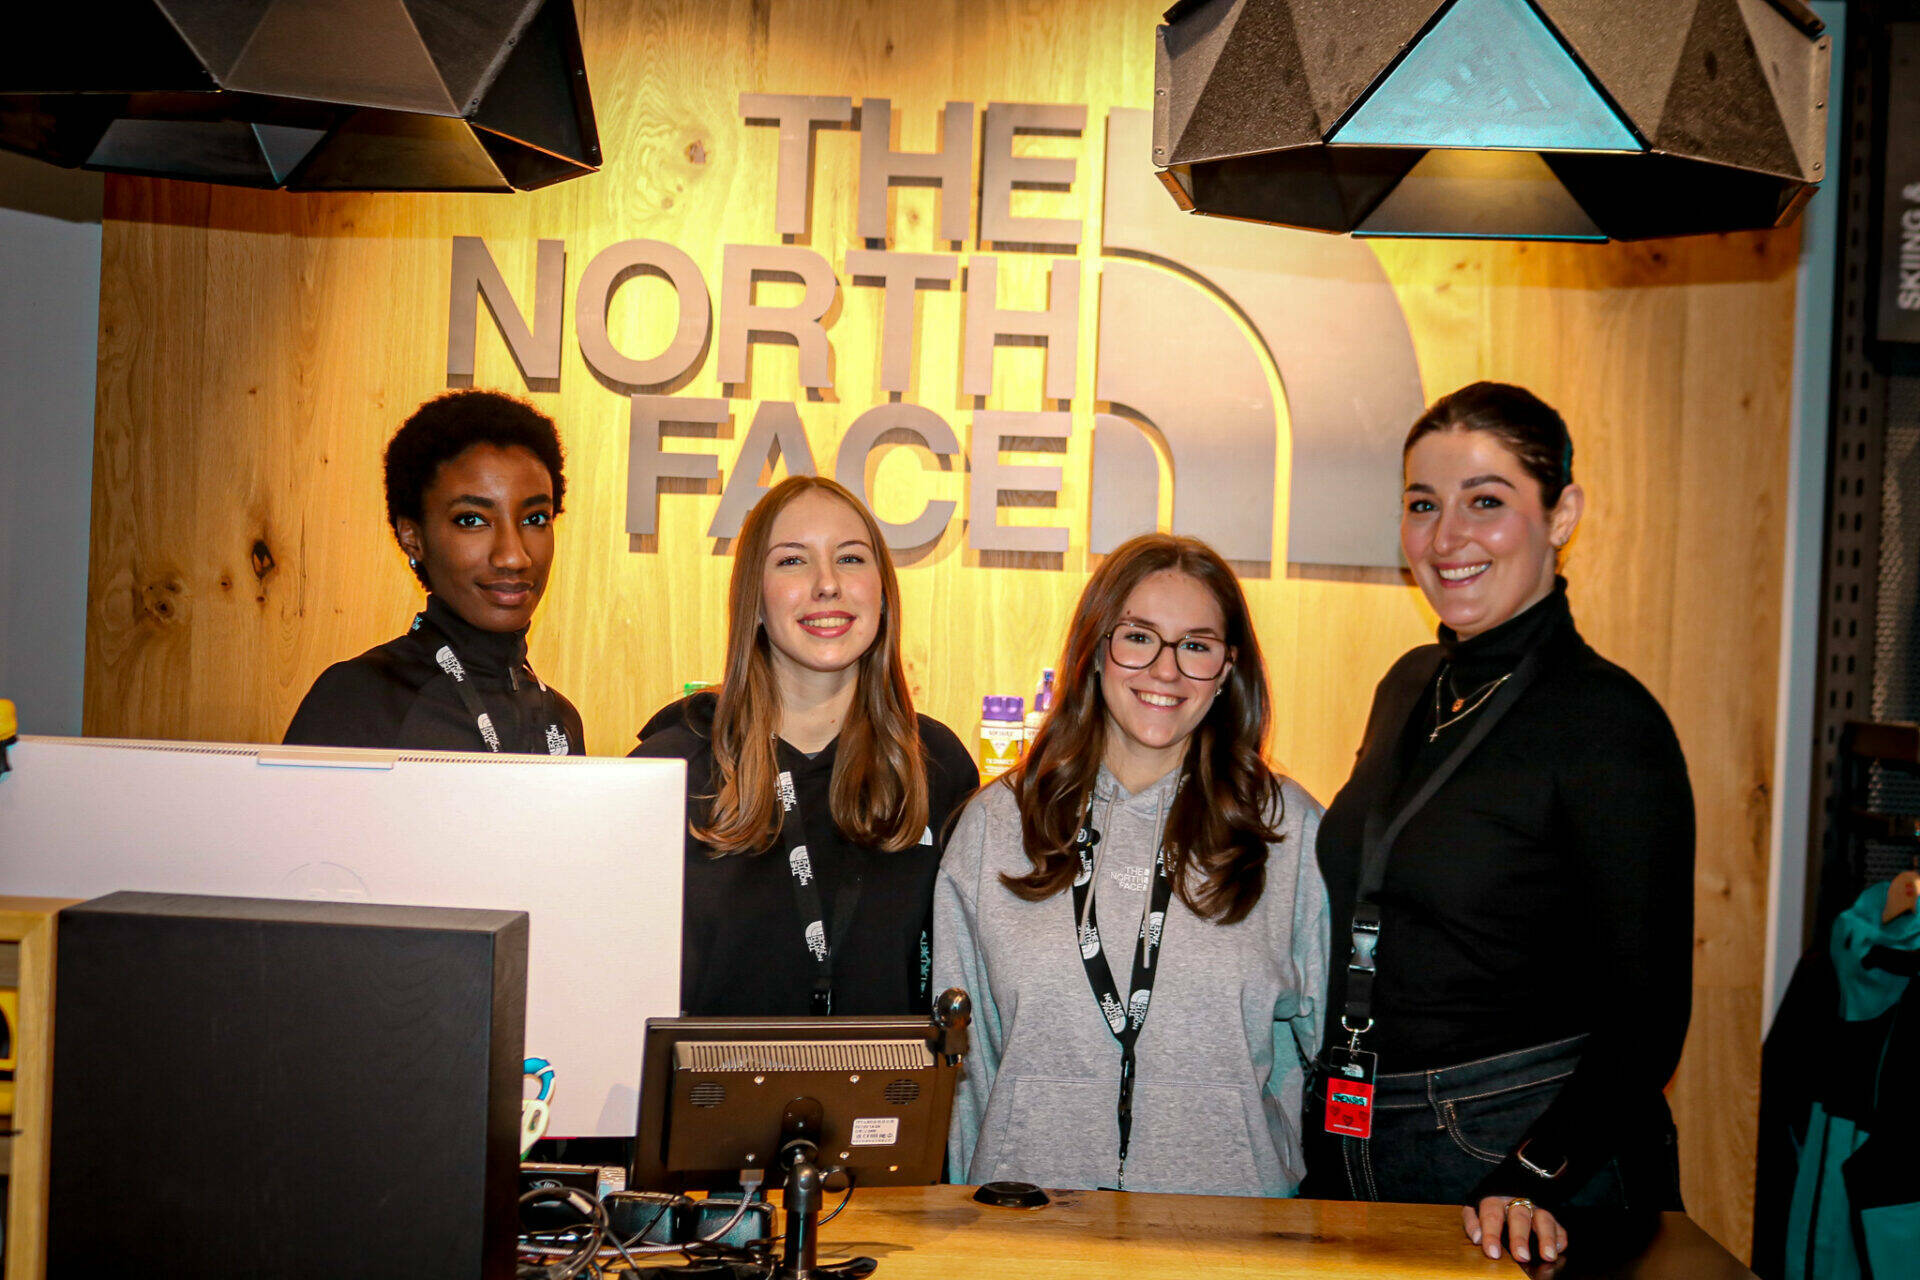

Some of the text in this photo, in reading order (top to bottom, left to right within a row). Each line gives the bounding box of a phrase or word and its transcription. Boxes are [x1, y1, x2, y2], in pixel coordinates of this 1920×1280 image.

[739, 94, 1088, 244] THE
[1898, 207, 1920, 309] SKIING
[447, 236, 1081, 399] NORTH
[626, 394, 1073, 553] FACE
[790, 861, 799, 876] THE
[796, 859, 807, 885] NORTH
[802, 858, 812, 878] FACE
[1110, 871, 1145, 883] NORTH
[1125, 865, 1144, 876] THE
[1119, 881, 1144, 892] FACE
[1089, 926, 1099, 942] THE
[1151, 925, 1160, 946] FACE
[1100, 1001, 1114, 1022] FACE
[1103, 992, 1119, 1019] NORTH
[1113, 1001, 1124, 1017] THE
[1128, 1001, 1136, 1018] THE
[1131, 1002, 1143, 1030] NORTH
